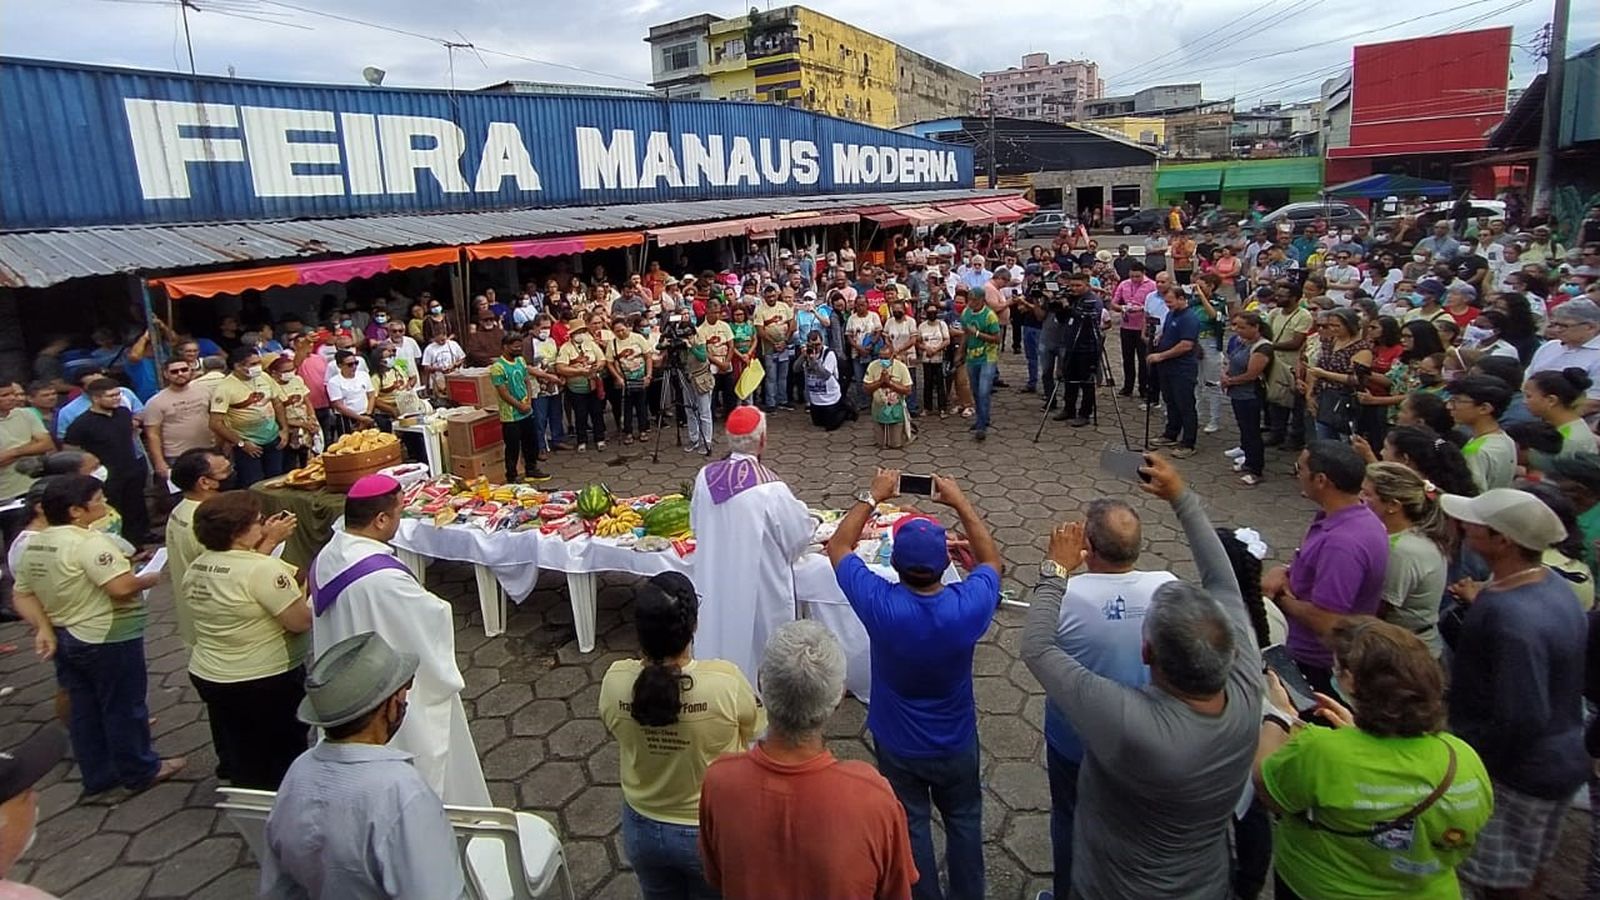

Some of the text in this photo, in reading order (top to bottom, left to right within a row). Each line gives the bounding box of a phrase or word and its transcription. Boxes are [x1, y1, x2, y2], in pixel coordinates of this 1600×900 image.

[124, 98, 959, 199] FEIRA MANAUS MODERNA
